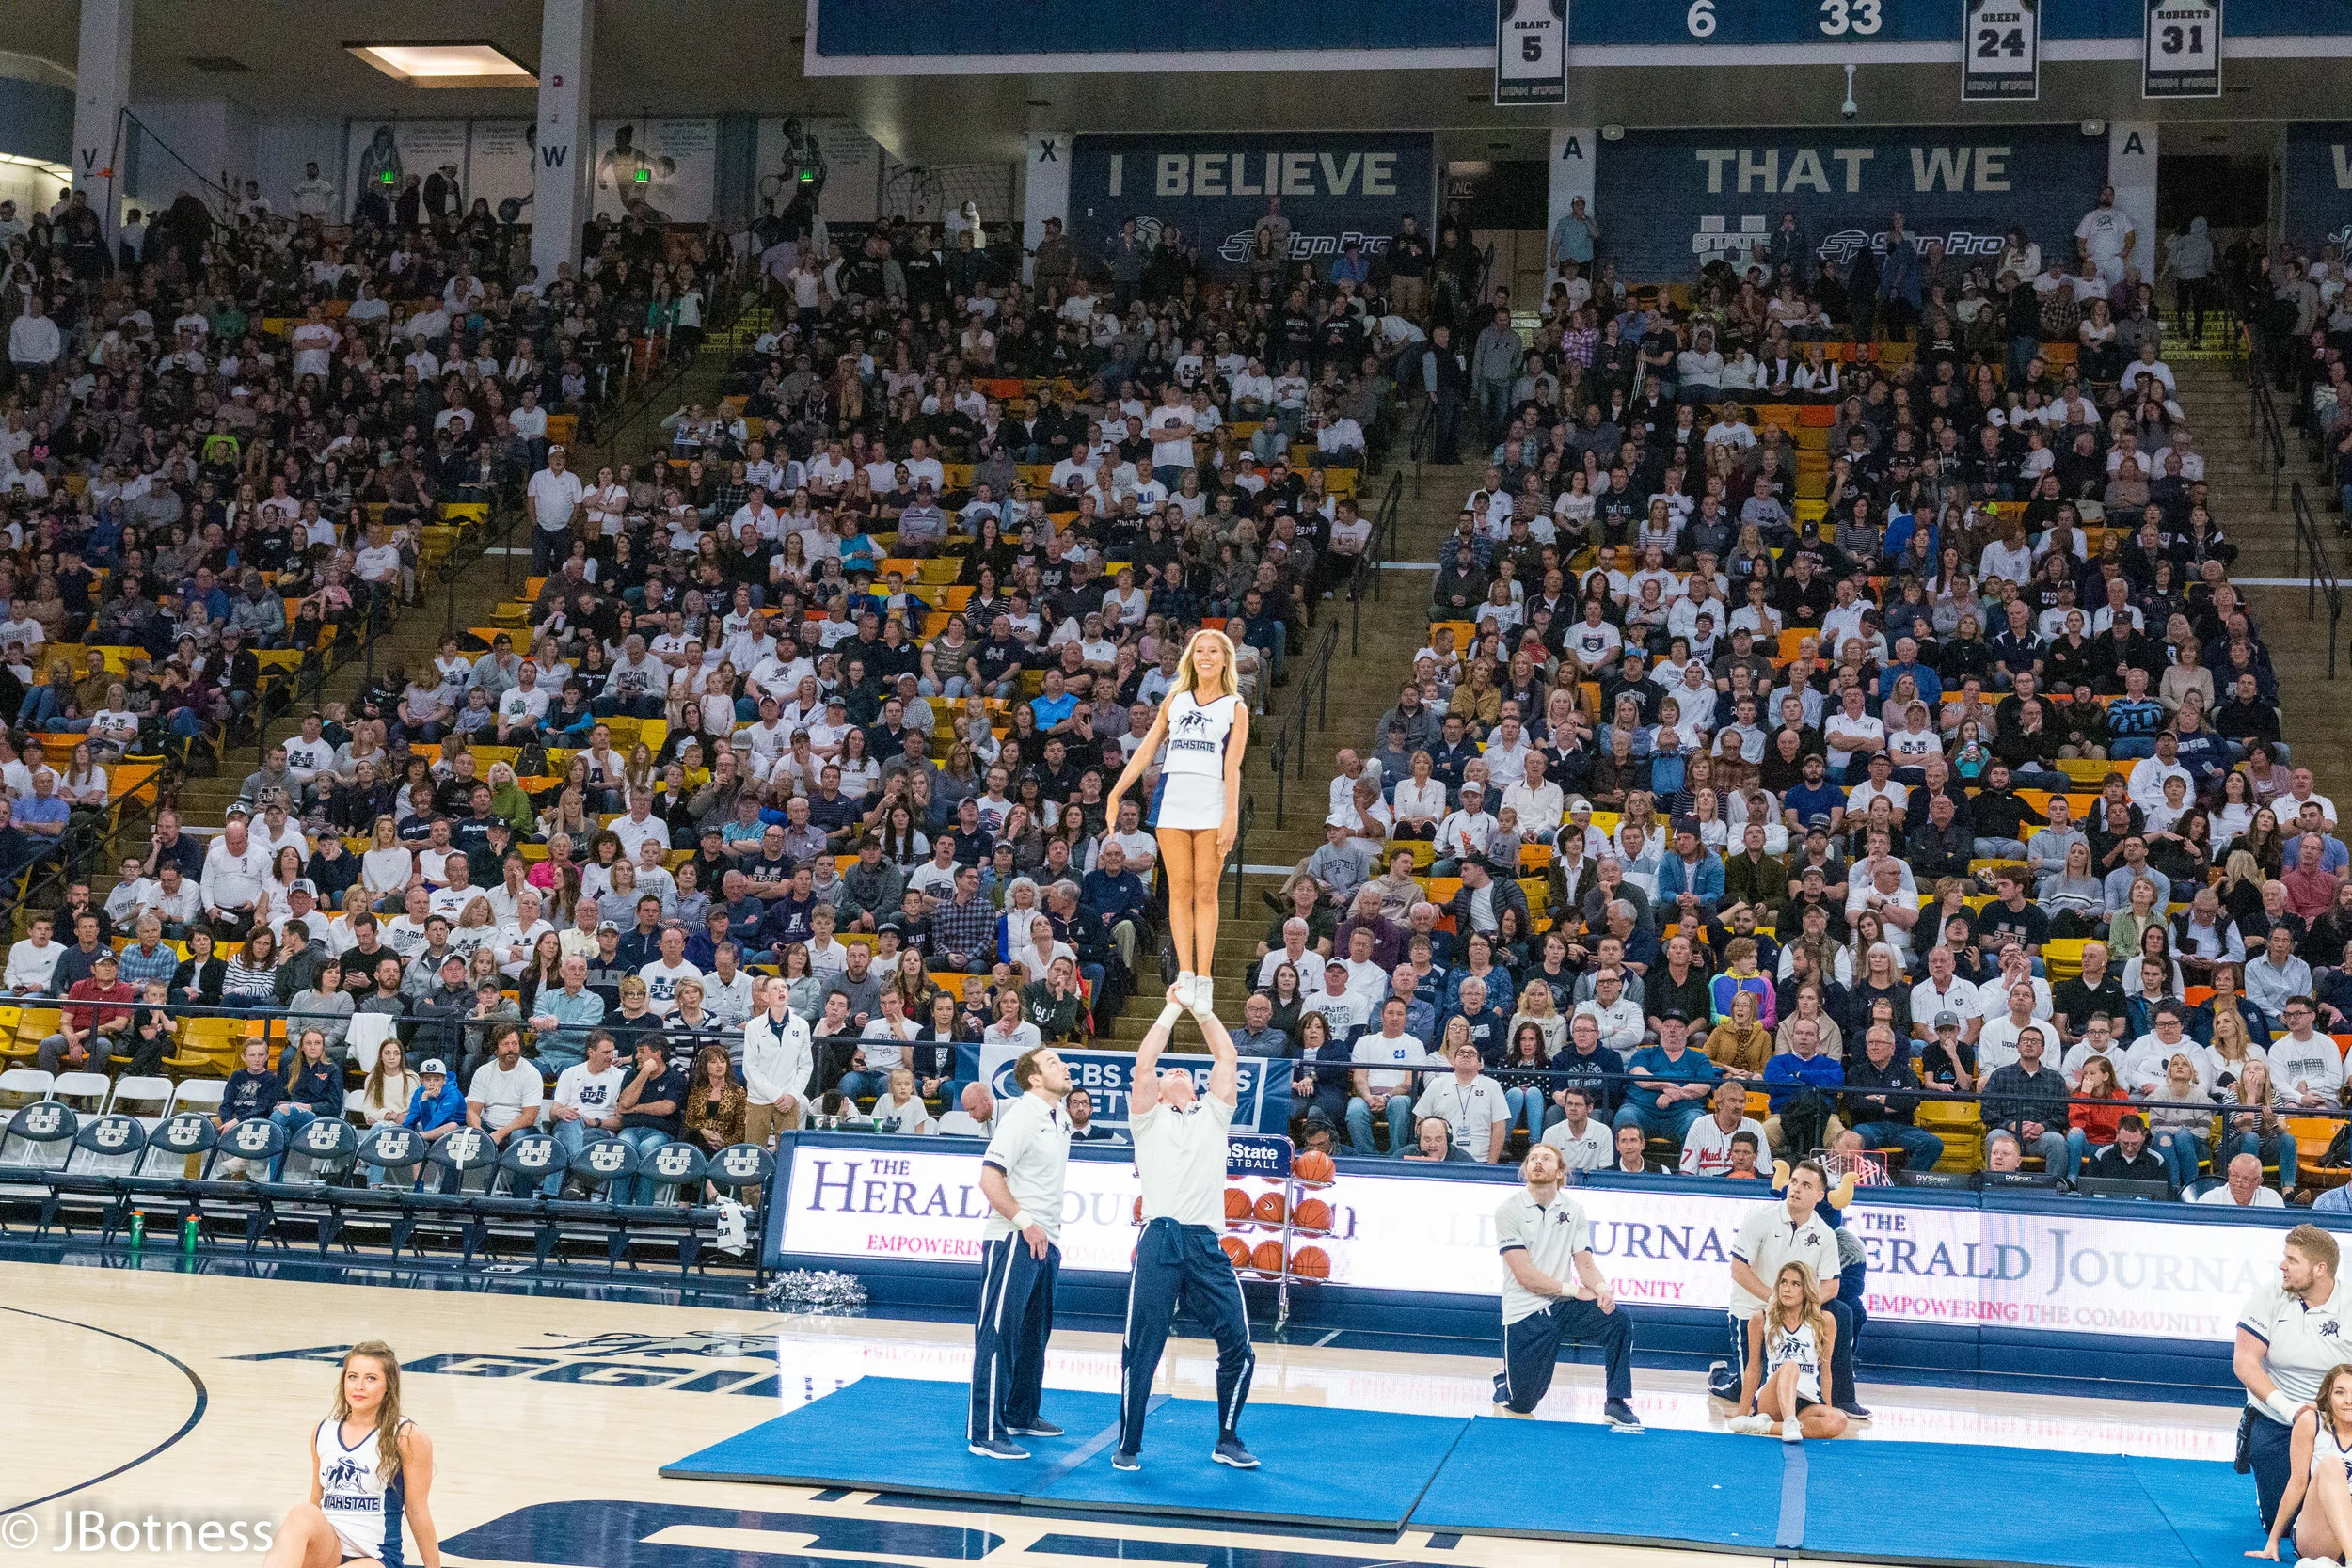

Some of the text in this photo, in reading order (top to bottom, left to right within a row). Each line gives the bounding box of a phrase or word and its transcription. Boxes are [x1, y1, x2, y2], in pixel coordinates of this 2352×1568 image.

[1687, 0, 1717, 38] 6
[1820, 0, 1882, 36] 33
[1981, 12, 2021, 23] GREEN
[2157, 9, 2210, 20] ROBERTS
[1514, 20, 1550, 30] GRANT
[1977, 29, 2025, 57] 24
[2162, 25, 2203, 54] 31
[1521, 35, 1543, 63] 5
[1039, 139, 1057, 163] X
[1562, 136, 1582, 160] A
[2122, 132, 2145, 155] A
[81, 149, 98, 170] V
[541, 146, 567, 167] W
[380, 170, 394, 182] EXIT
[634, 169, 648, 181] EXIT
[800, 169, 814, 180] EXIT
[1109, 153, 1398, 196] I BELIEVE
[1695, 147, 2012, 193] THAT WE
[1692, 232, 1772, 254] STATE
[1946, 231, 2006, 255] Pro
[1189, 740, 1216, 753] STATE
[288, 754, 314, 766] STATE
[1338, 859, 1355, 871] STATE
[636, 878, 665, 887] GGIES
[650, 984, 675, 994] STAT
[1068, 1062, 1121, 1087] CBS
[25, 1114, 61, 1125] STATE
[95, 1128, 130, 1139] STATE
[167, 1126, 201, 1137] STATE
[236, 1132, 270, 1143] STATE
[308, 1130, 341, 1141] STATE
[375, 1139, 409, 1150] STATE
[446, 1140, 481, 1152] STTE
[1228, 1142, 1278, 1159] State
[516, 1148, 551, 1158] STATE
[590, 1151, 625, 1163] STATE
[656, 1155, 691, 1166] STATE
[1680, 1149, 1692, 1167] 7
[1699, 1149, 1723, 1163] Mud
[723, 1157, 759, 1166] STATE
[871, 1159, 911, 1176] THE
[1228, 1159, 1278, 1170] ETBALL
[806, 1160, 991, 1220] HERAL
[1862, 1213, 1906, 1231] THE
[866, 1234, 984, 1256] EMPOWERIN
[1588, 1220, 1732, 1263] URNA
[1864, 1228, 2267, 1295] ERALD JOURNA
[1610, 1279, 1685, 1300] MUNITY
[1867, 1293, 2221, 1335] EMPOWERING THE COMMUNITY
[344, 1495, 379, 1511] STATE
